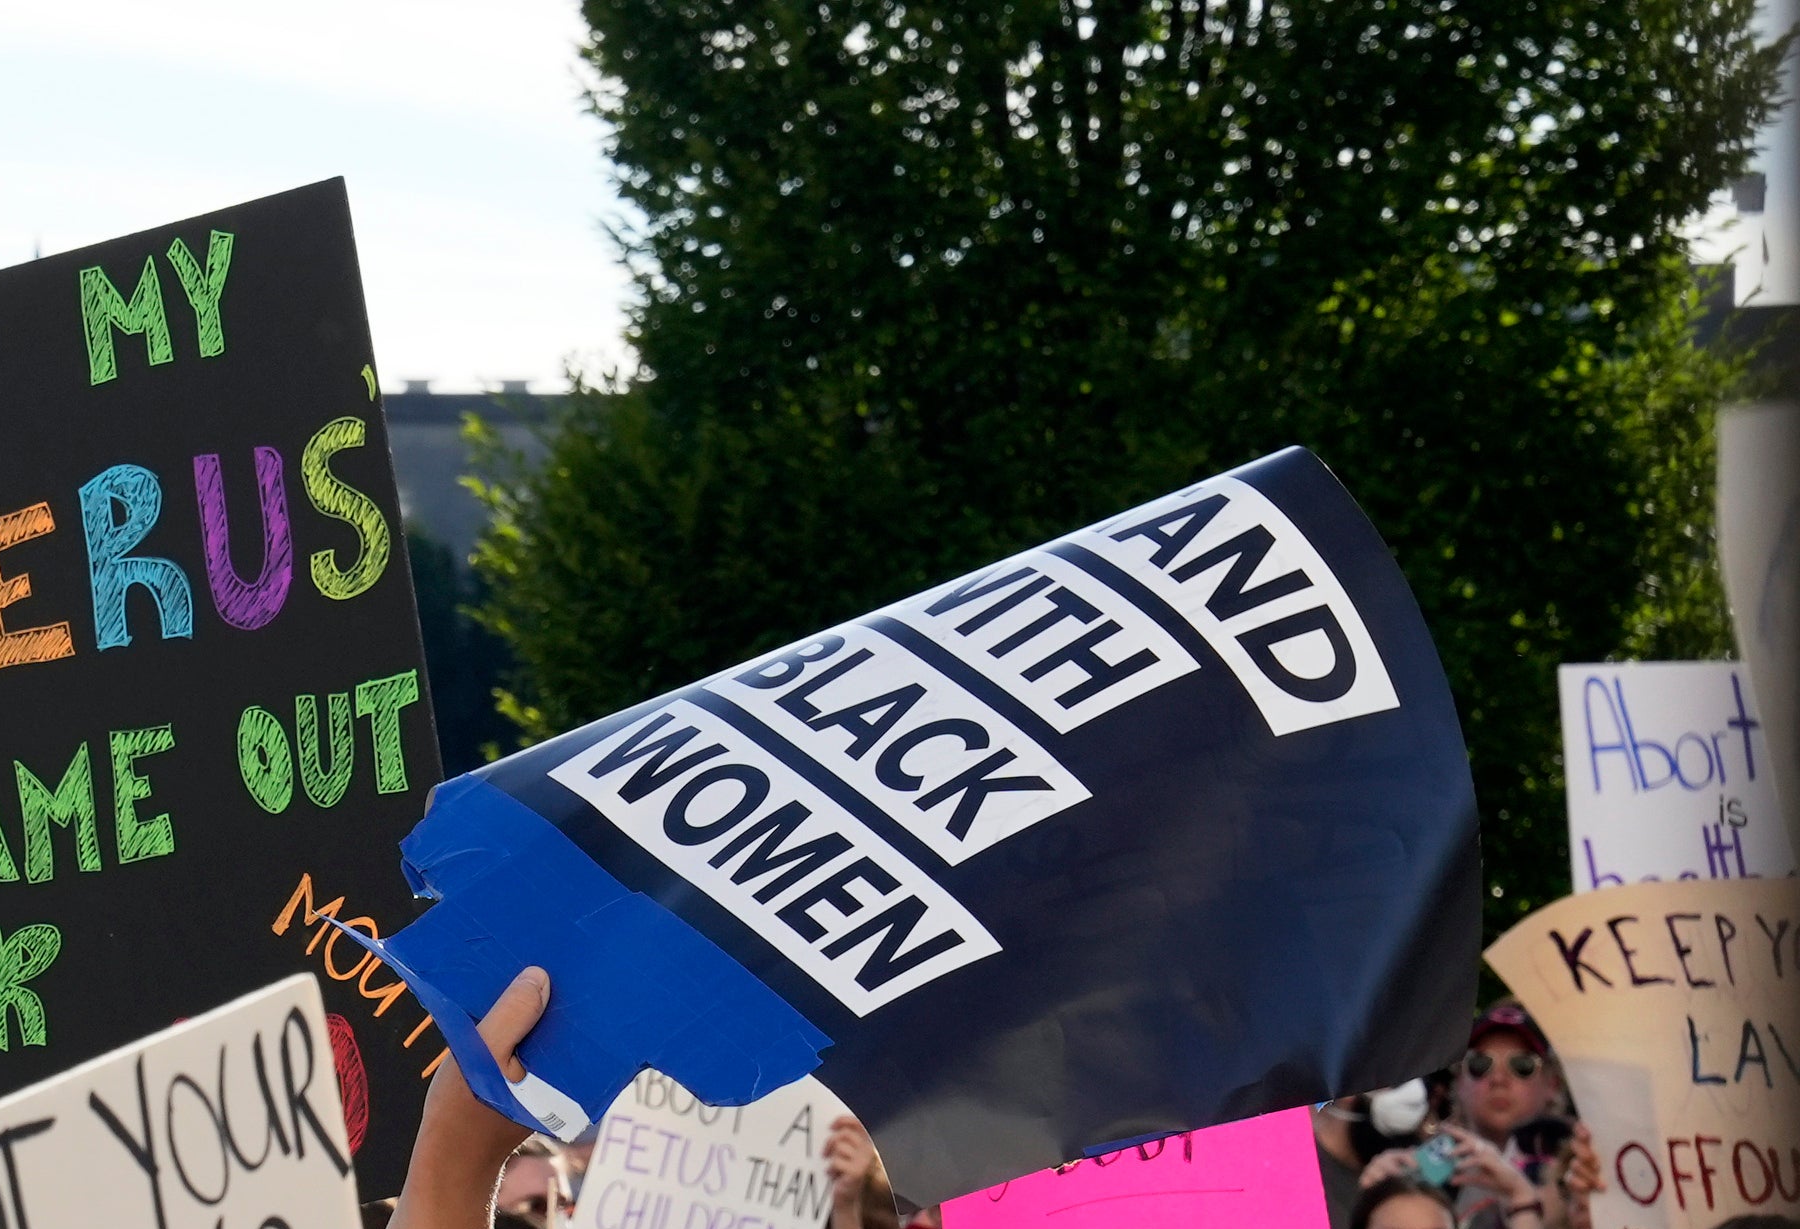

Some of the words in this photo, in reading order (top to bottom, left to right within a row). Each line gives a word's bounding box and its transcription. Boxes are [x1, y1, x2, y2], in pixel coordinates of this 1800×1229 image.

[79, 230, 235, 386] MY
[237, 669, 420, 814] OUT
[733, 634, 1056, 842] BLACK
[589, 711, 966, 993] WOMEN
[1719, 796, 1748, 828] is
[1549, 912, 1736, 993] KEEP
[598, 1114, 737, 1197] FETUS
[744, 1156, 834, 1221] THAN
[779, 1103, 813, 1158] A
[1615, 1133, 1722, 1211] OFF
